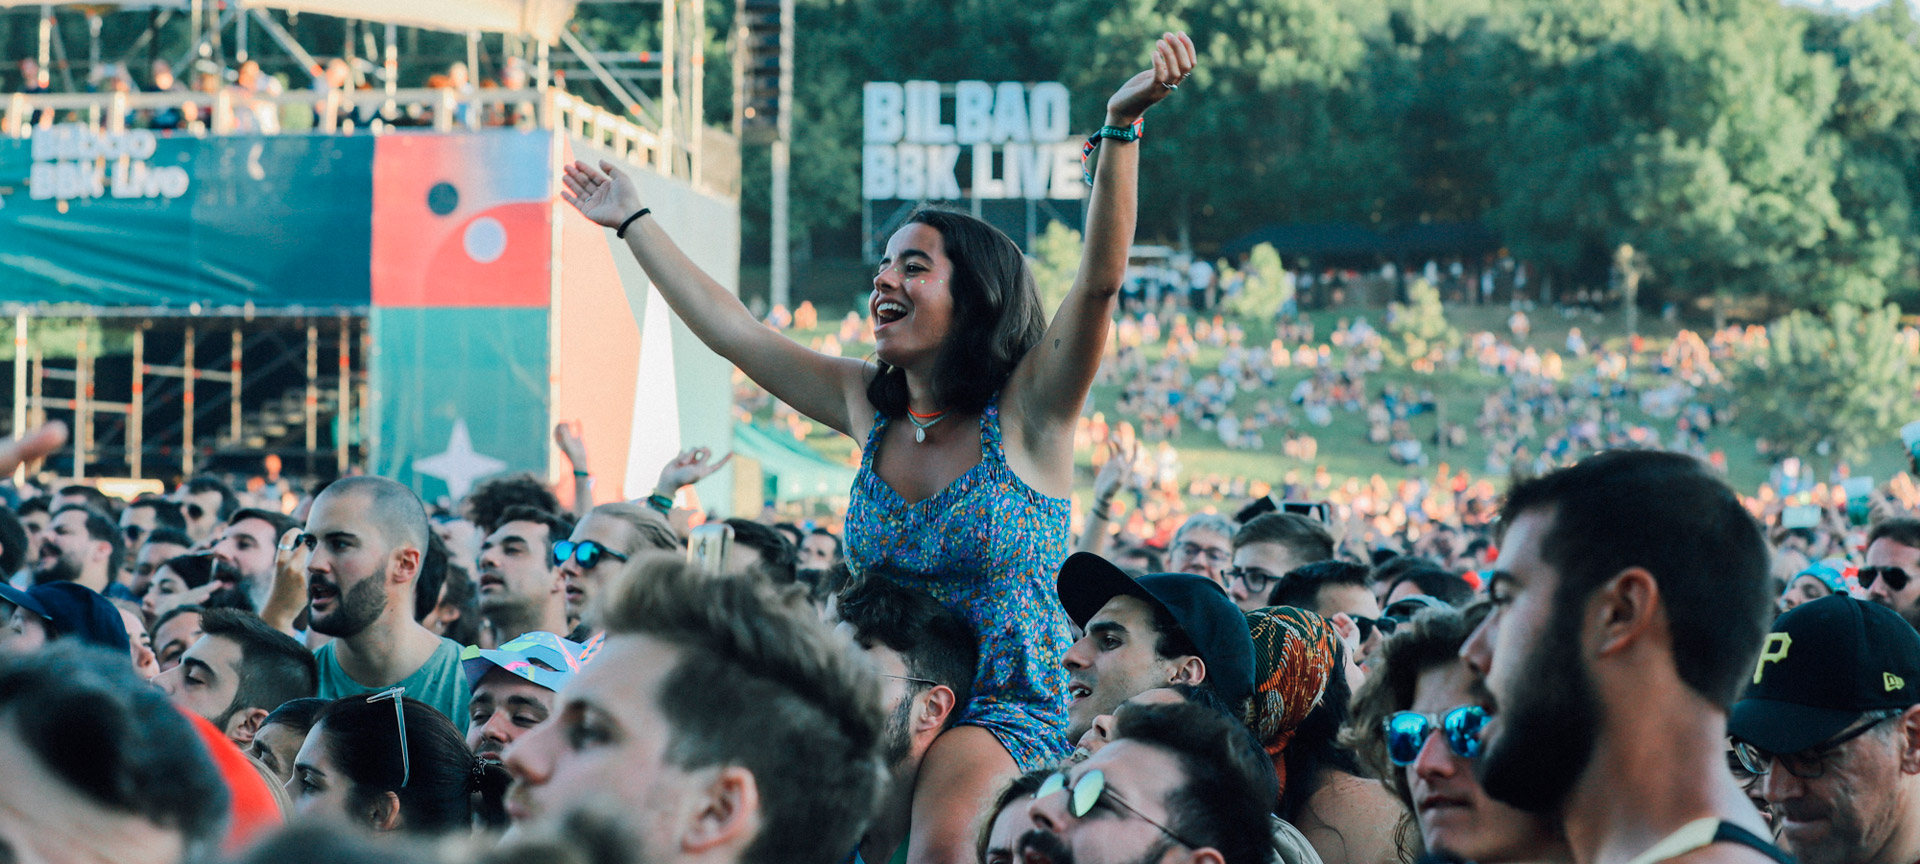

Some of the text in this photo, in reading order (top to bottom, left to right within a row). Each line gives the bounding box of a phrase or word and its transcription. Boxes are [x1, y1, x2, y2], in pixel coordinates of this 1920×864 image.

[863, 80, 1070, 145] BILBAO
[862, 137, 1086, 200] BBK LIVE
[1753, 631, 1793, 685] P
